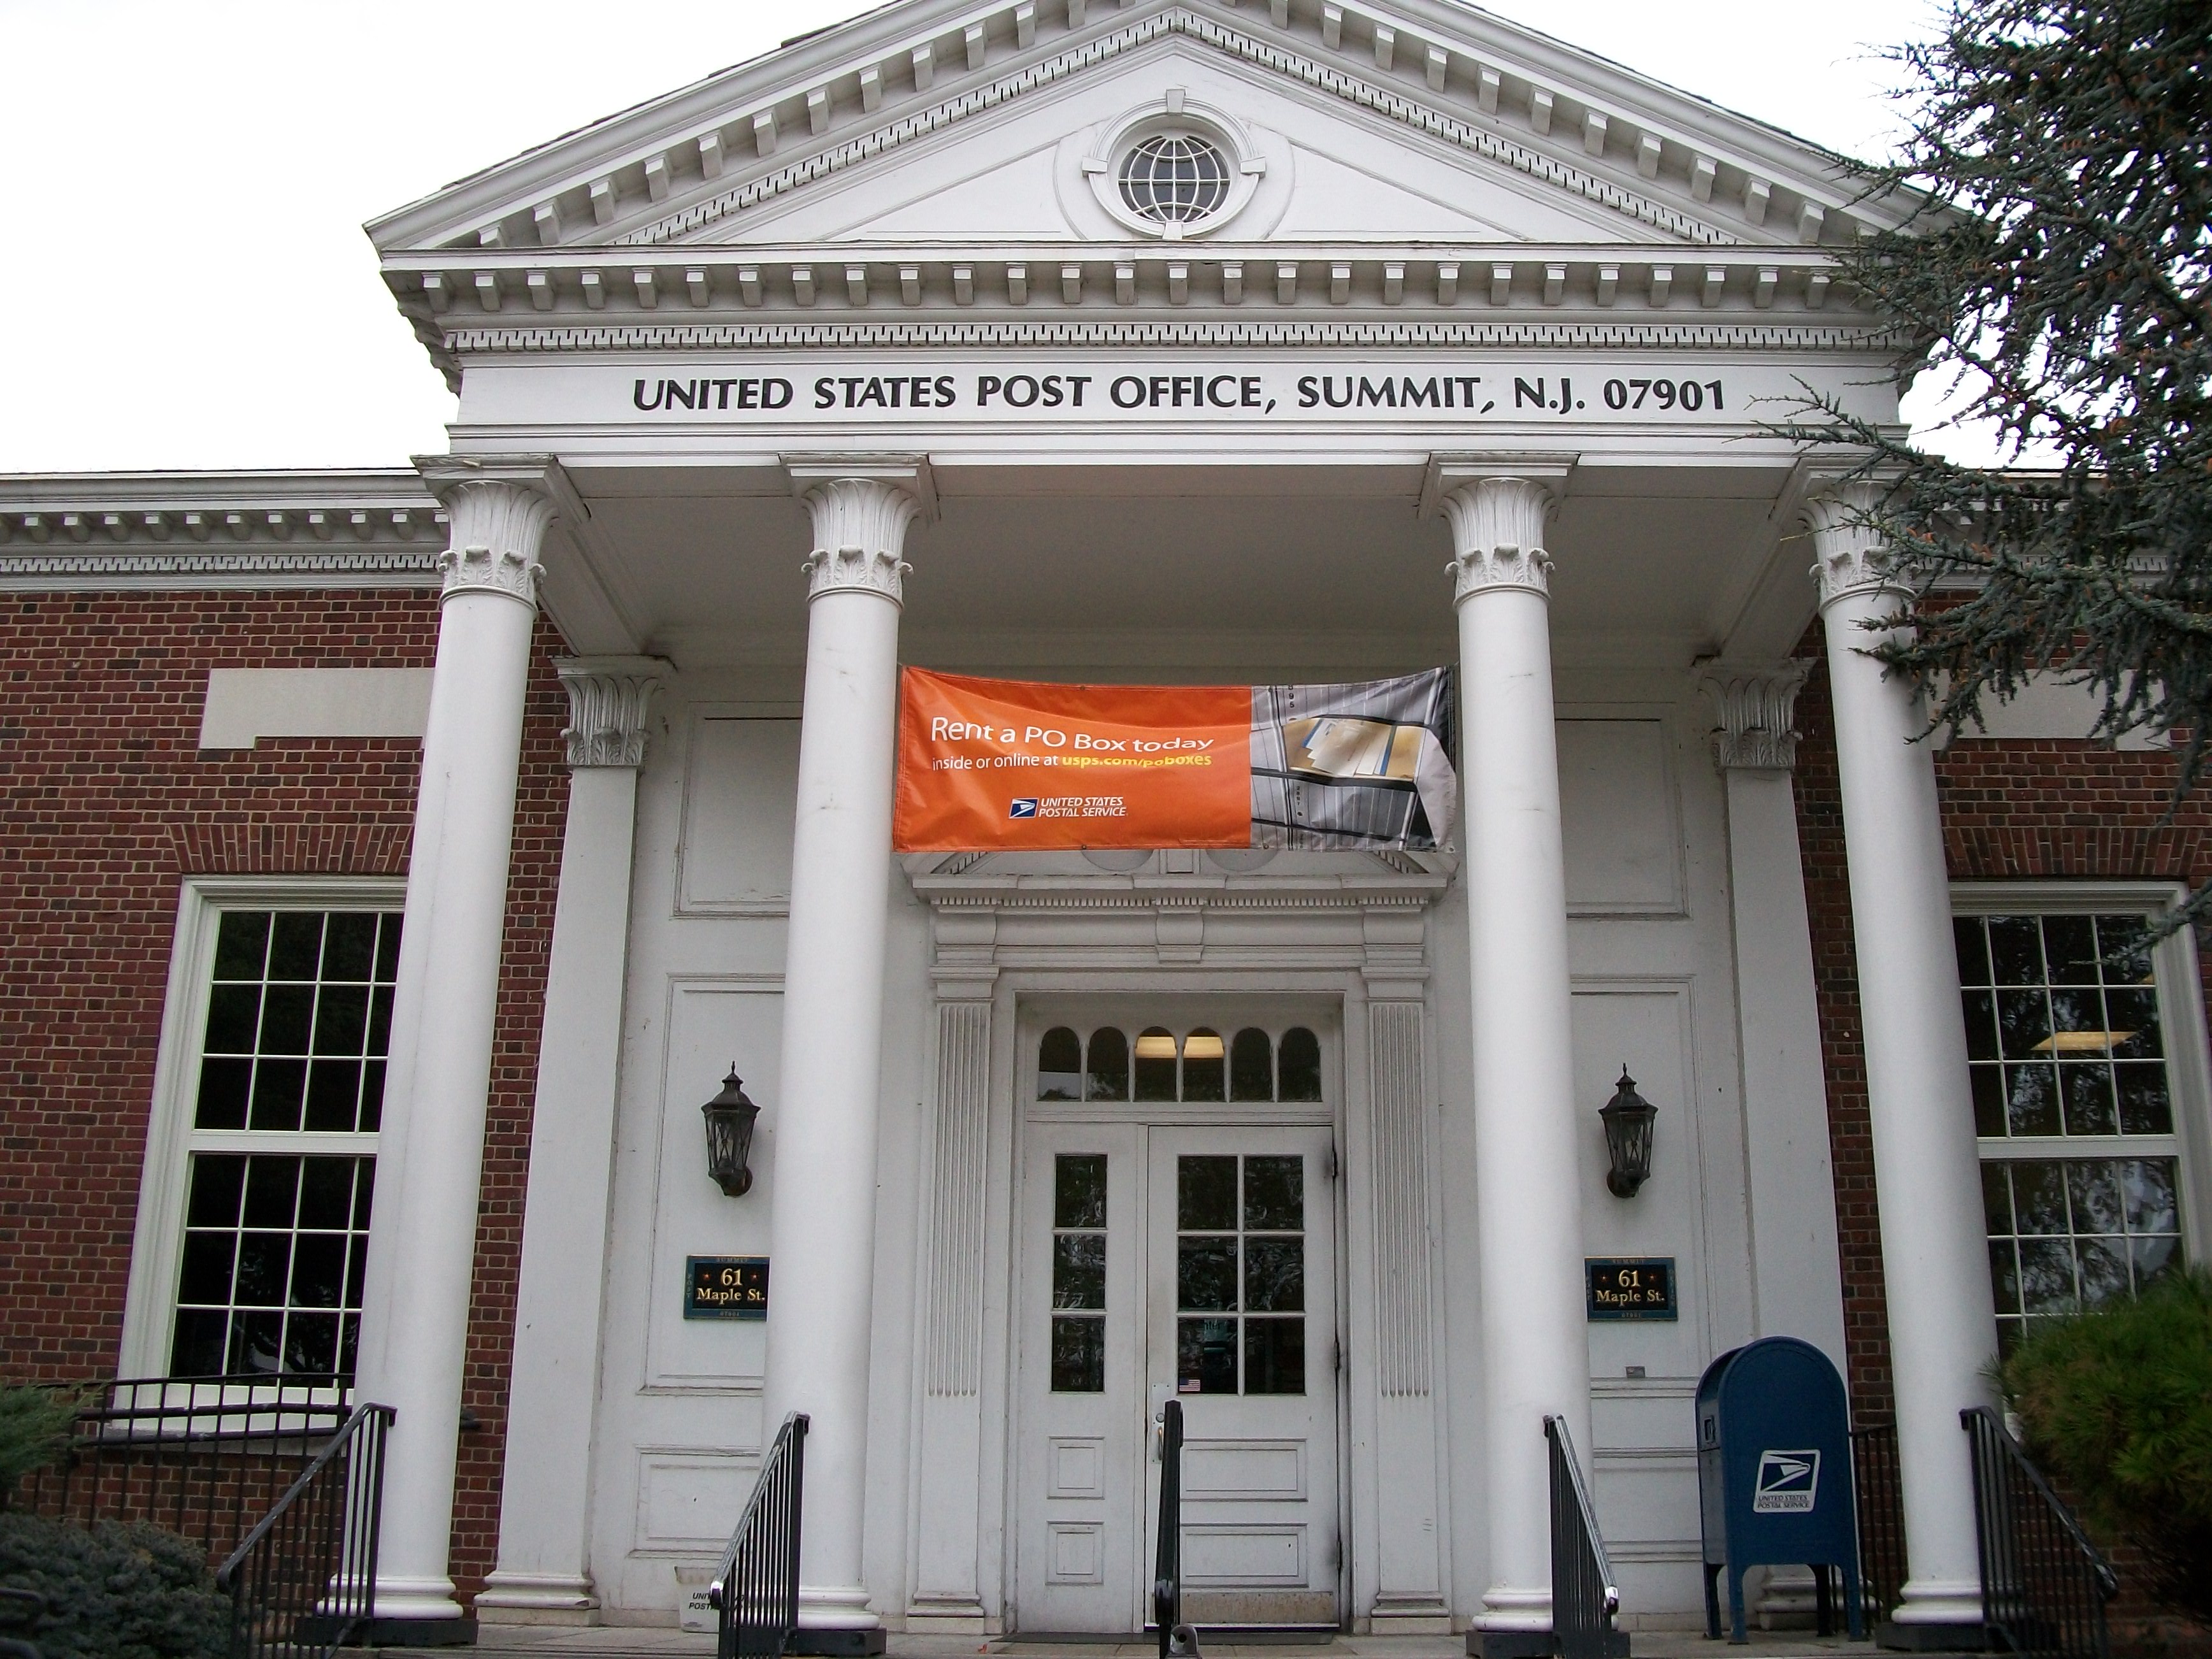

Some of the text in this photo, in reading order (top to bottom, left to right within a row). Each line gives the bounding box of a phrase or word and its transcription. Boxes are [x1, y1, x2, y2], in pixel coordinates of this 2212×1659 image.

[634, 375, 1723, 414] UNITED STATES POST OFFICE, SUMMIT, N.J. 07901
[931, 717, 1214, 752] Rent a PO Box today
[932, 753, 1212, 771] inside or online at usps.com/poboxes
[1040, 796, 1124, 807] UNITED STATES
[1038, 807, 1127, 818] POSTAL SERVICE
[721, 1268, 742, 1286] 61
[1618, 1270, 1641, 1287] 61
[696, 1288, 765, 1305] Maple St.
[1596, 1289, 1665, 1306] Maple St.
